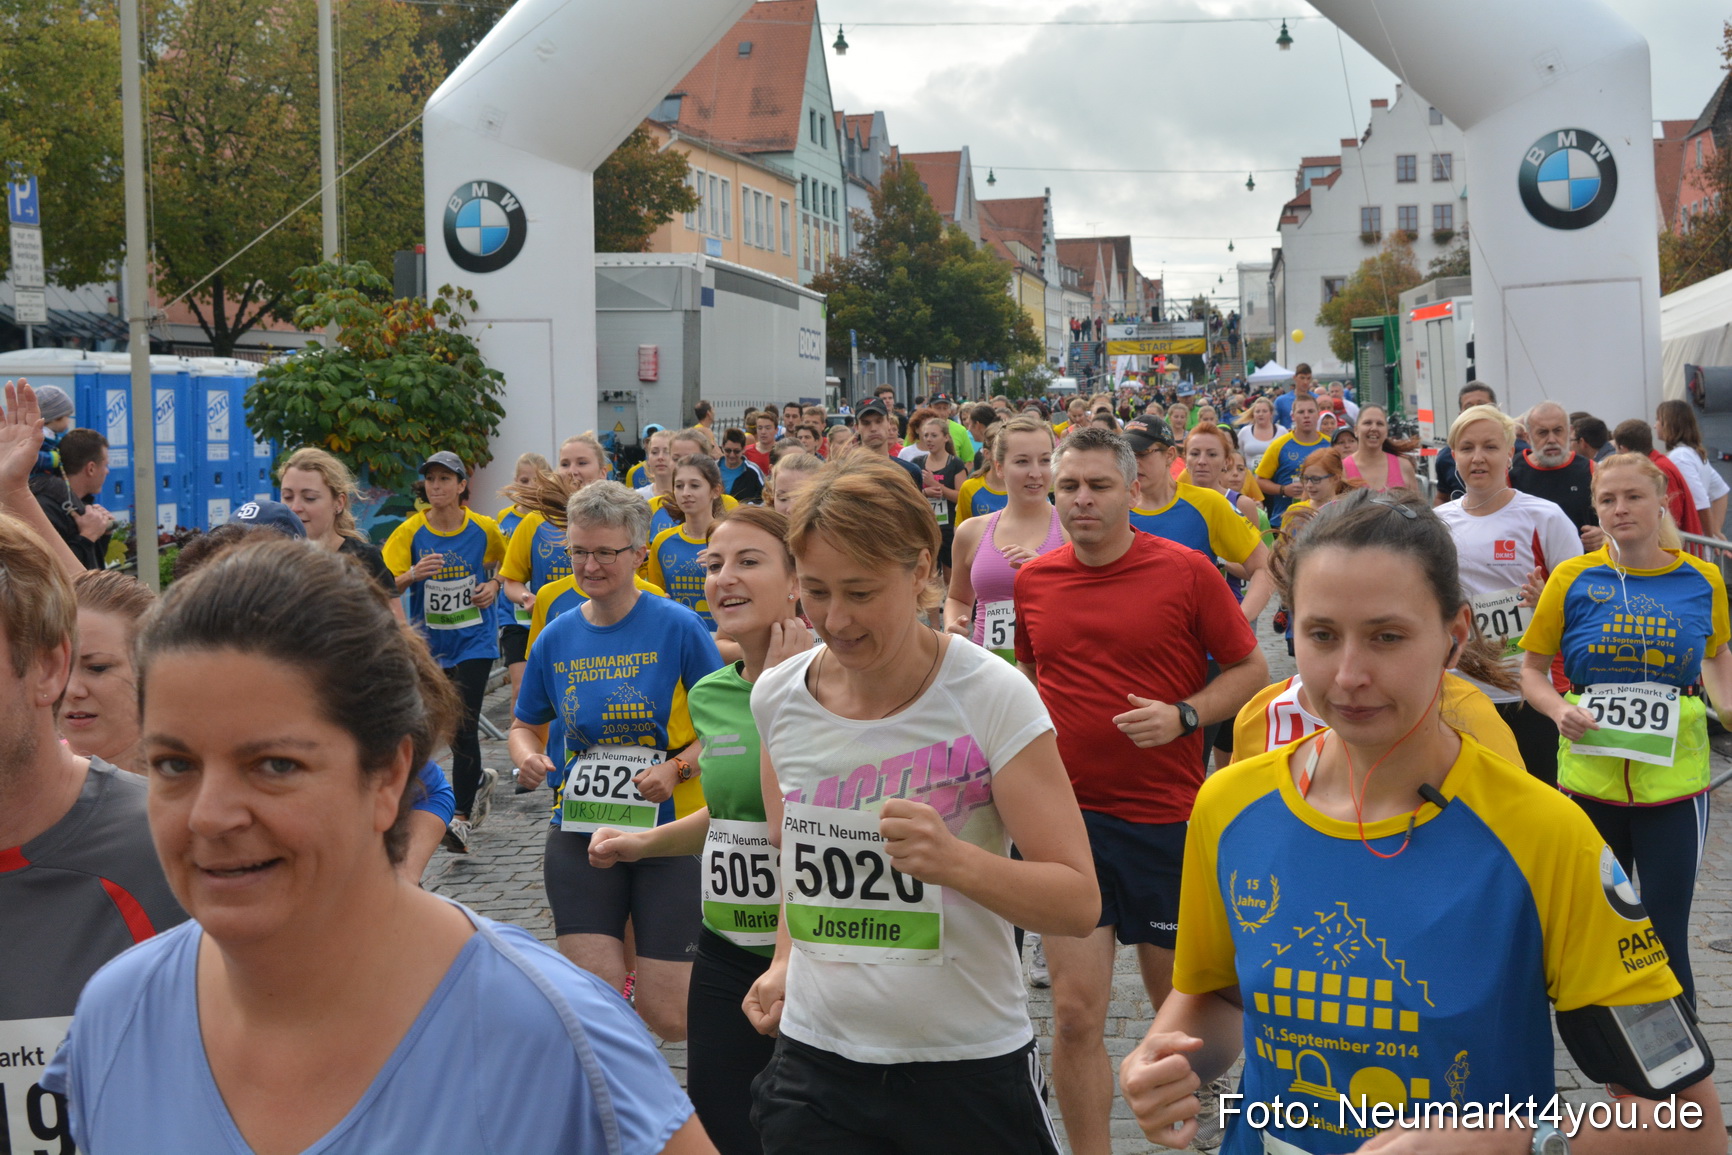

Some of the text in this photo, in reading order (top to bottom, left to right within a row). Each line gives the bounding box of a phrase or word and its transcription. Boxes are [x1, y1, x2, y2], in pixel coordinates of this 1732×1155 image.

[1526, 131, 1610, 167] BMW
[448, 182, 520, 213] BMW
[1139, 342, 1174, 352] START
[107, 395, 127, 424] DIXI
[156, 394, 175, 422] DIXI
[208, 395, 229, 422] DIXI
[430, 588, 472, 612] 5218
[1475, 595, 1514, 609] Neumarkt
[440, 614, 465, 624] Sabine
[987, 608, 1010, 617] PARTL
[553, 651, 658, 673] 10. NEUMARKTER
[568, 666, 640, 684] STADTLAUF
[1618, 686, 1662, 698] Neumarkt
[1586, 697, 1669, 731] 5539
[602, 751, 647, 764] Neumarkt
[569, 802, 632, 823] URSULA
[708, 831, 732, 844] PARTL
[785, 817, 826, 837] PARTL
[711, 850, 781, 899] 505
[795, 842, 924, 904] 5020
[1246, 879, 1259, 890] 15
[1237, 895, 1267, 908] Jahre
[733, 909, 778, 928] Maria
[813, 915, 901, 941] Josefine
[1618, 927, 1660, 959] PAR
[1622, 949, 1666, 974] Neum
[0, 1046, 45, 1067] arkt
[1375, 1041, 1420, 1059] 2014
